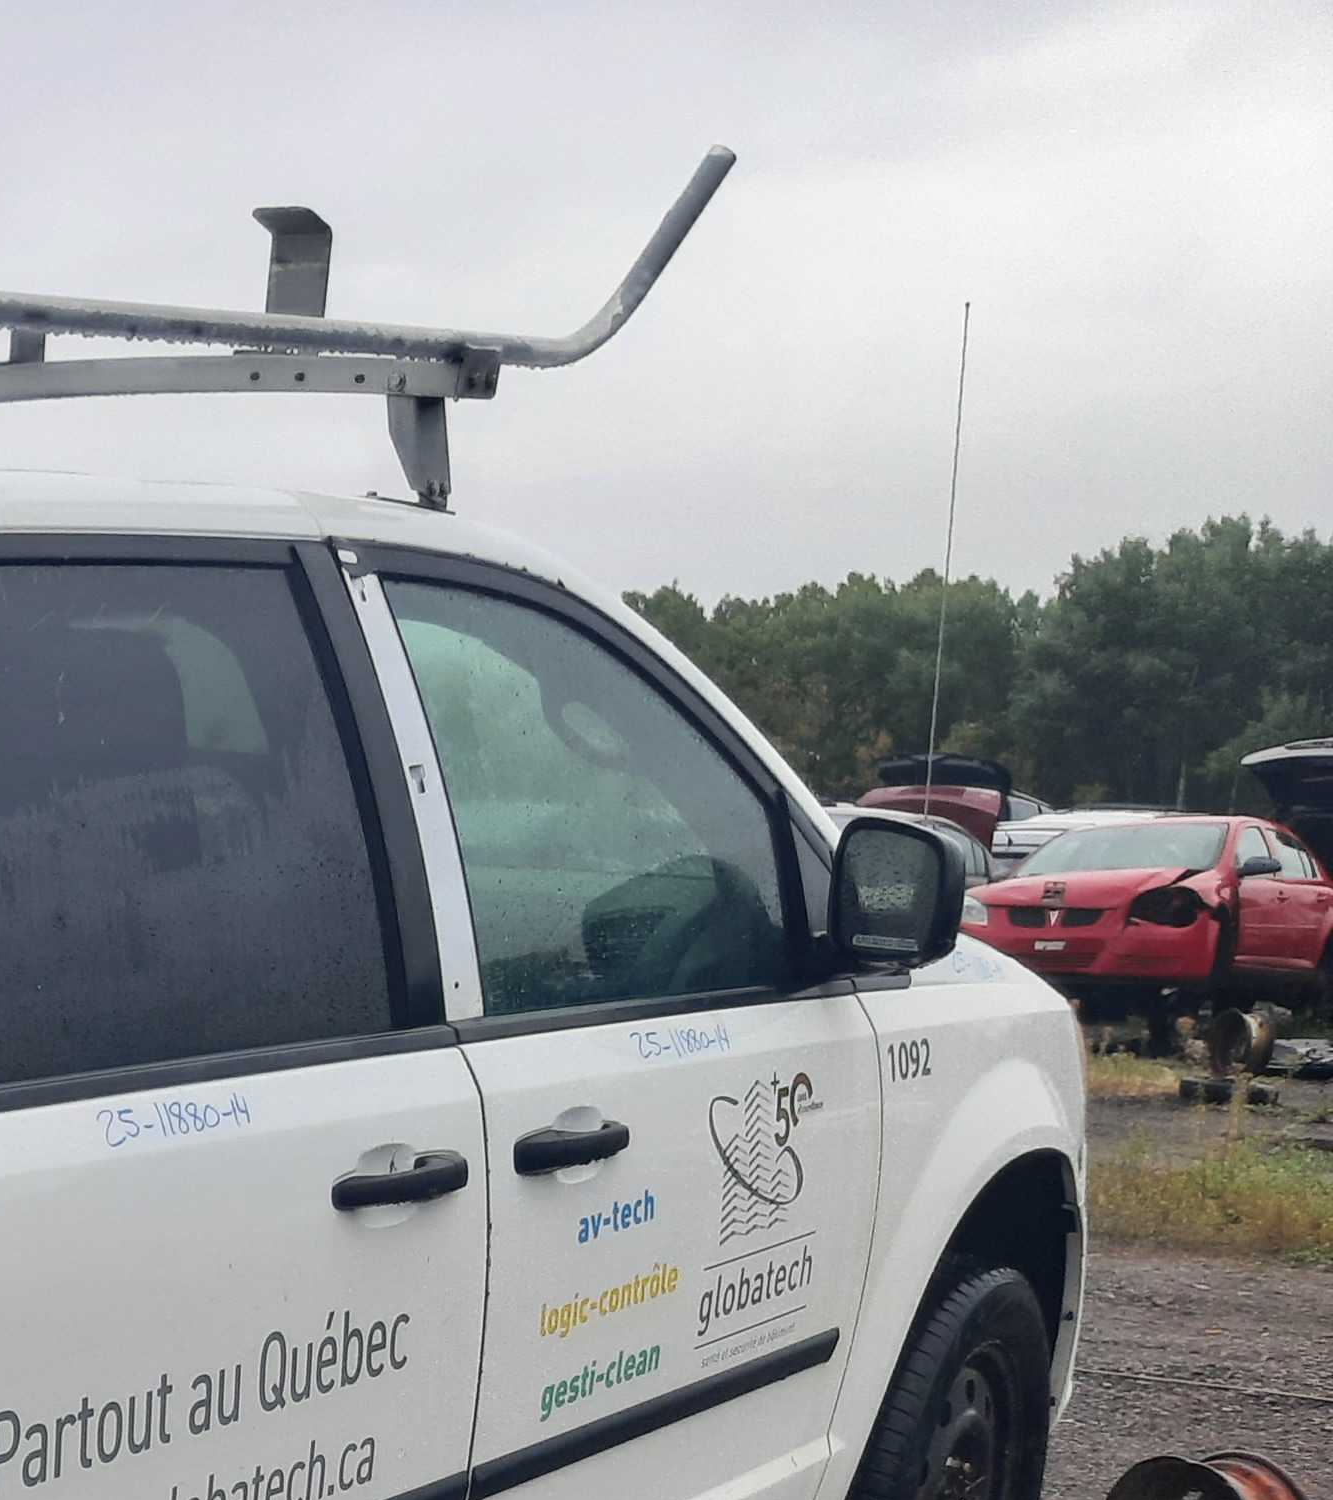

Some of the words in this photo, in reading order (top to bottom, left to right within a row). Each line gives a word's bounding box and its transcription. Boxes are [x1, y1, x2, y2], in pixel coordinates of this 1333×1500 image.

[629, 1023, 730, 1059] 25-11880-14
[887, 1037, 932, 1082] 1092
[95, 1092, 252, 1147] 25-11880-14
[578, 1189, 655, 1243] av-tech
[539, 1262, 679, 1338] logic-contrôle
[697, 1245, 812, 1337] globatech
[188, 1364, 242, 1435] au
[259, 1311, 410, 1413] Québec
[539, 1344, 661, 1422] gesti-clean
